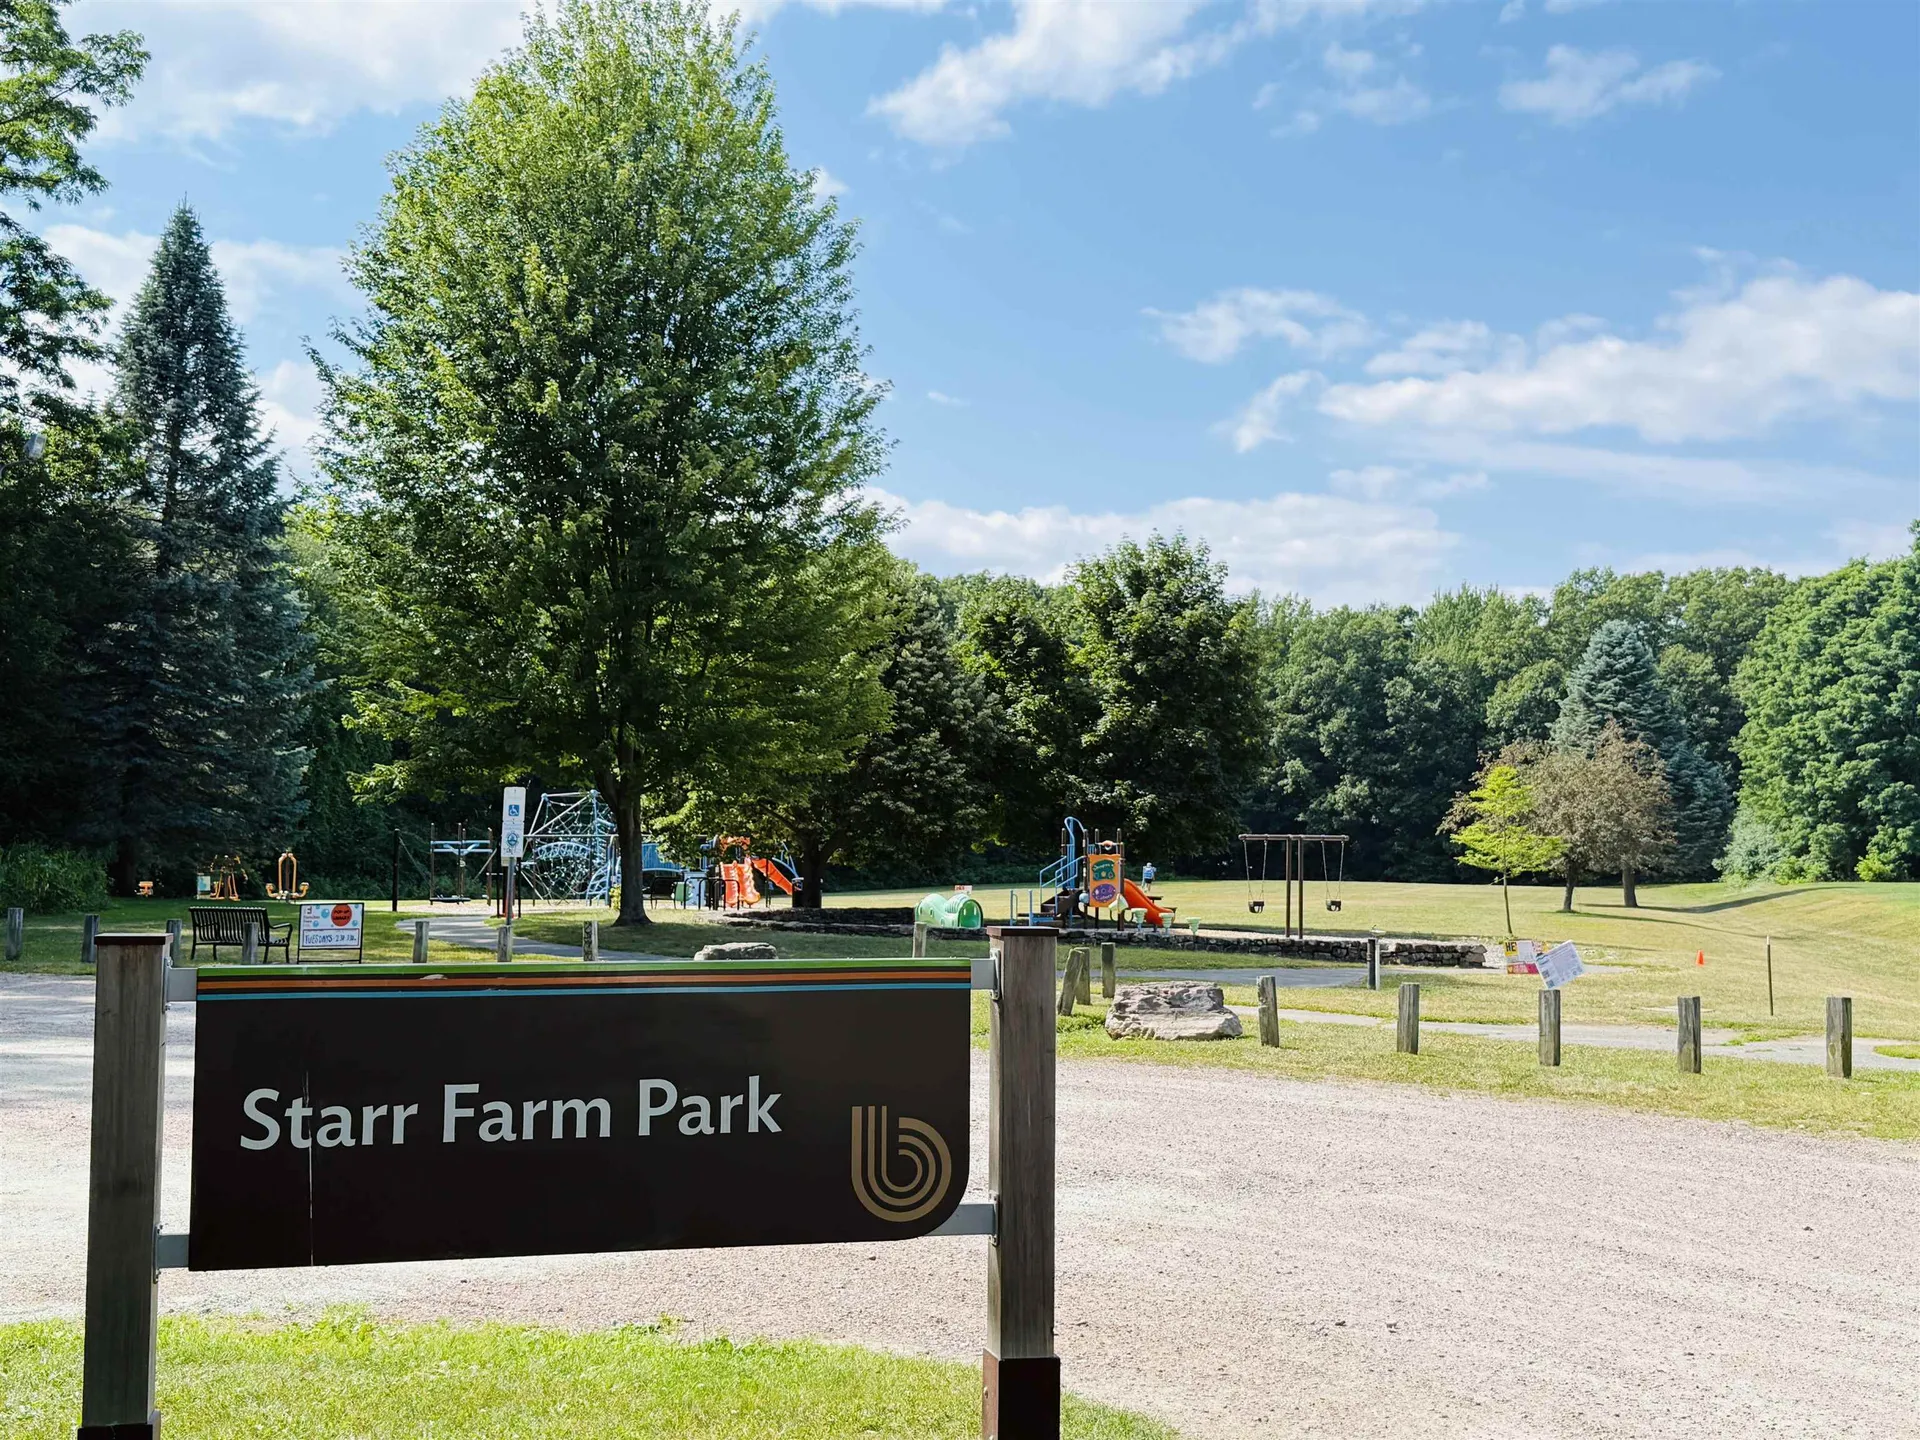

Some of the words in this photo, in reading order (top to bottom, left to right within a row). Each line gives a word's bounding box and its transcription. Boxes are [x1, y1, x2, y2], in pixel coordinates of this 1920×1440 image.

[305, 934, 333, 945] TUESDAYS
[241, 1088, 419, 1151] Starr
[442, 1084, 611, 1143] Farm
[638, 1075, 783, 1137] Park
